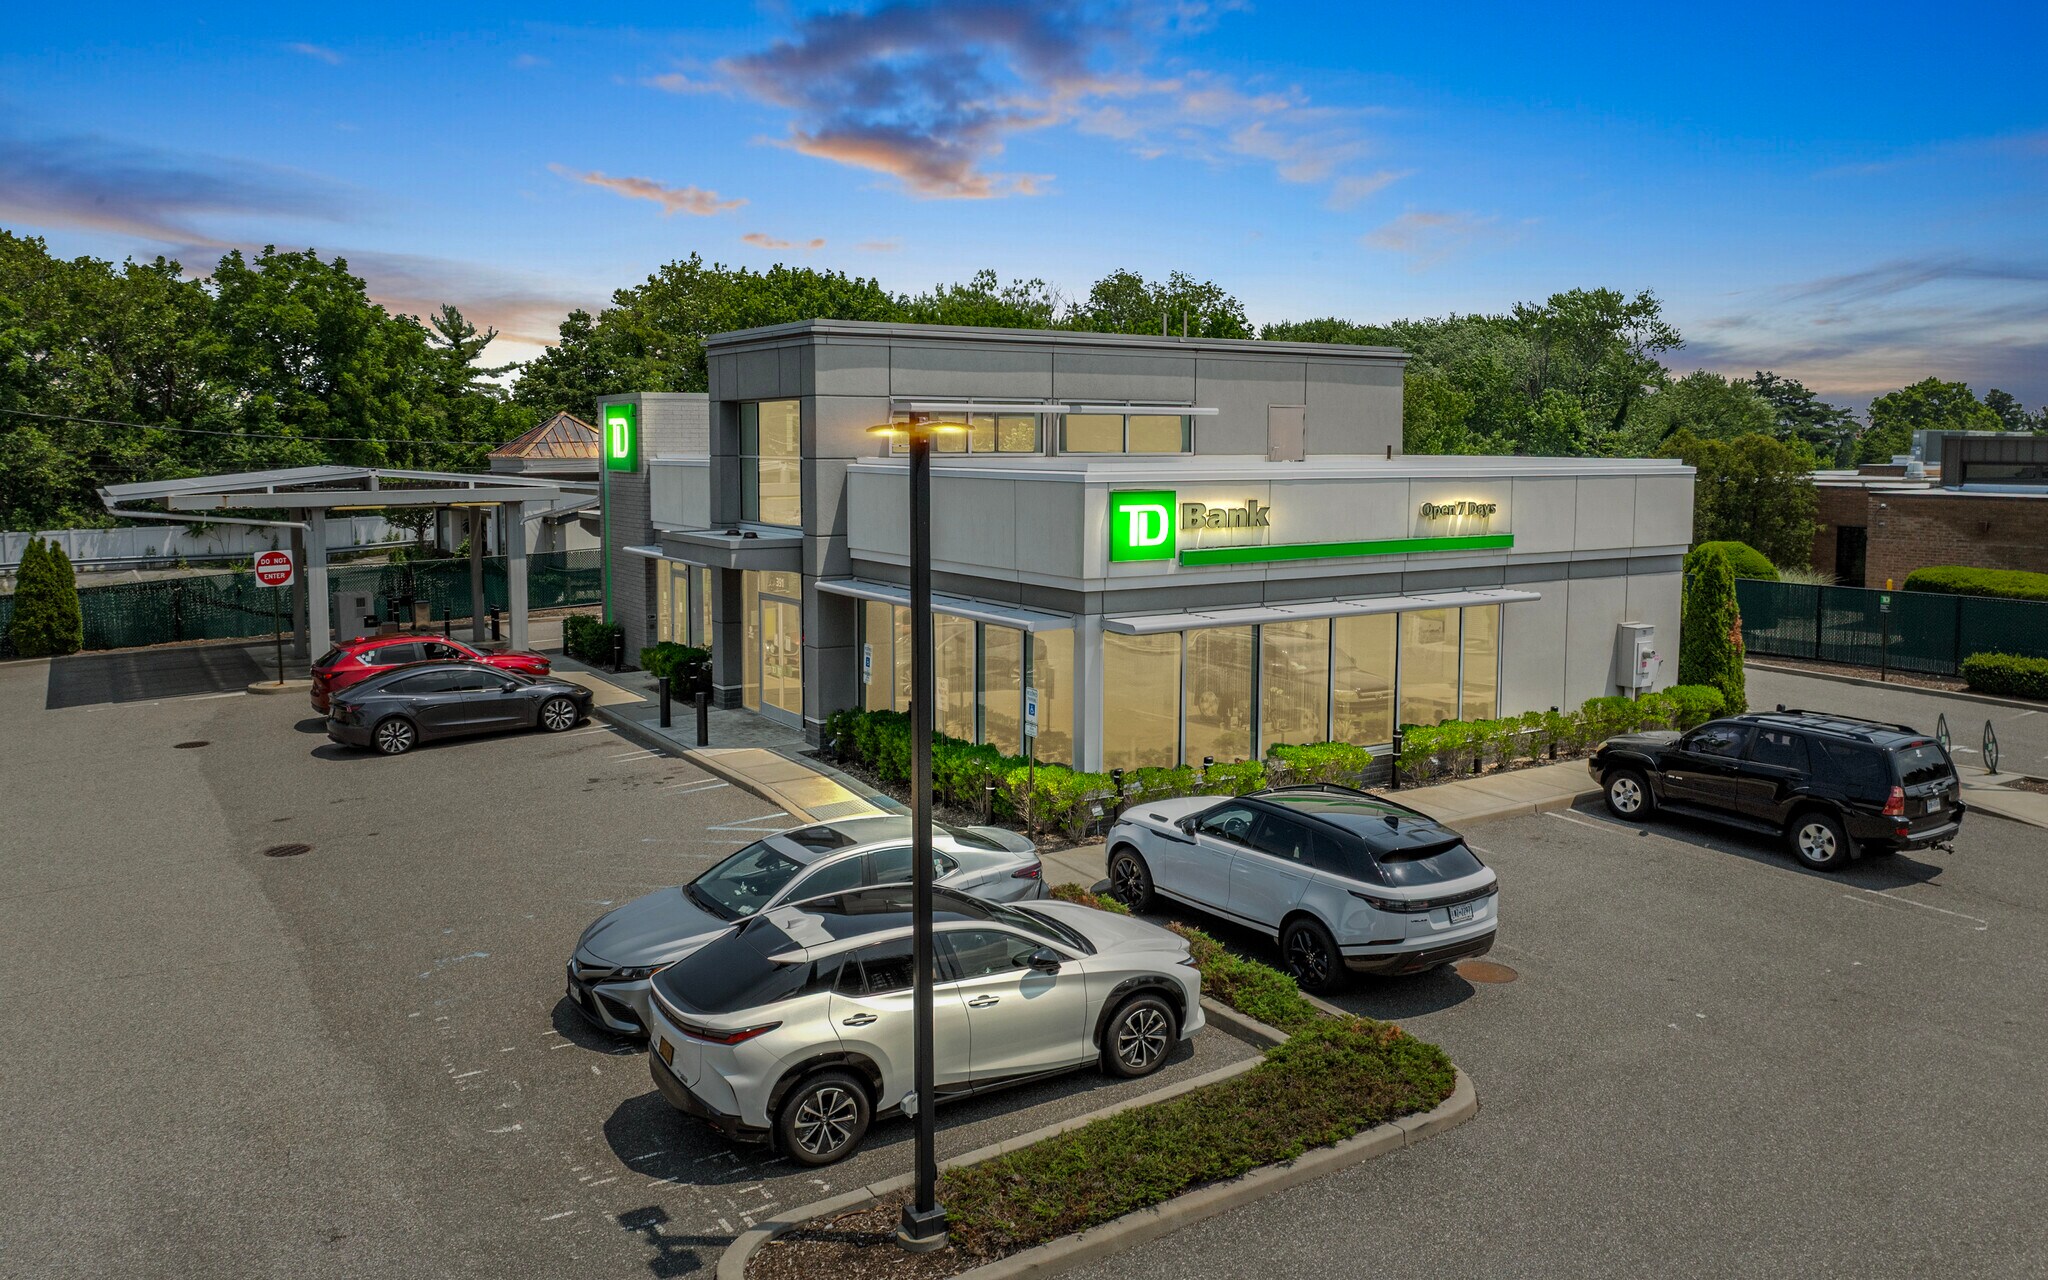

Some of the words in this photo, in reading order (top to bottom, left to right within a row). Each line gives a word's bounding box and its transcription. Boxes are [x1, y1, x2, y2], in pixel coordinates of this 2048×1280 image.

[608, 417, 629, 458] TD
[1119, 504, 1169, 547] TD
[1180, 499, 1271, 530] Bank
[1421, 502, 1456, 520] Open
[1457, 501, 1466, 515] 7
[1467, 501, 1497, 518] Days
[264, 572, 286, 580] ENTER
